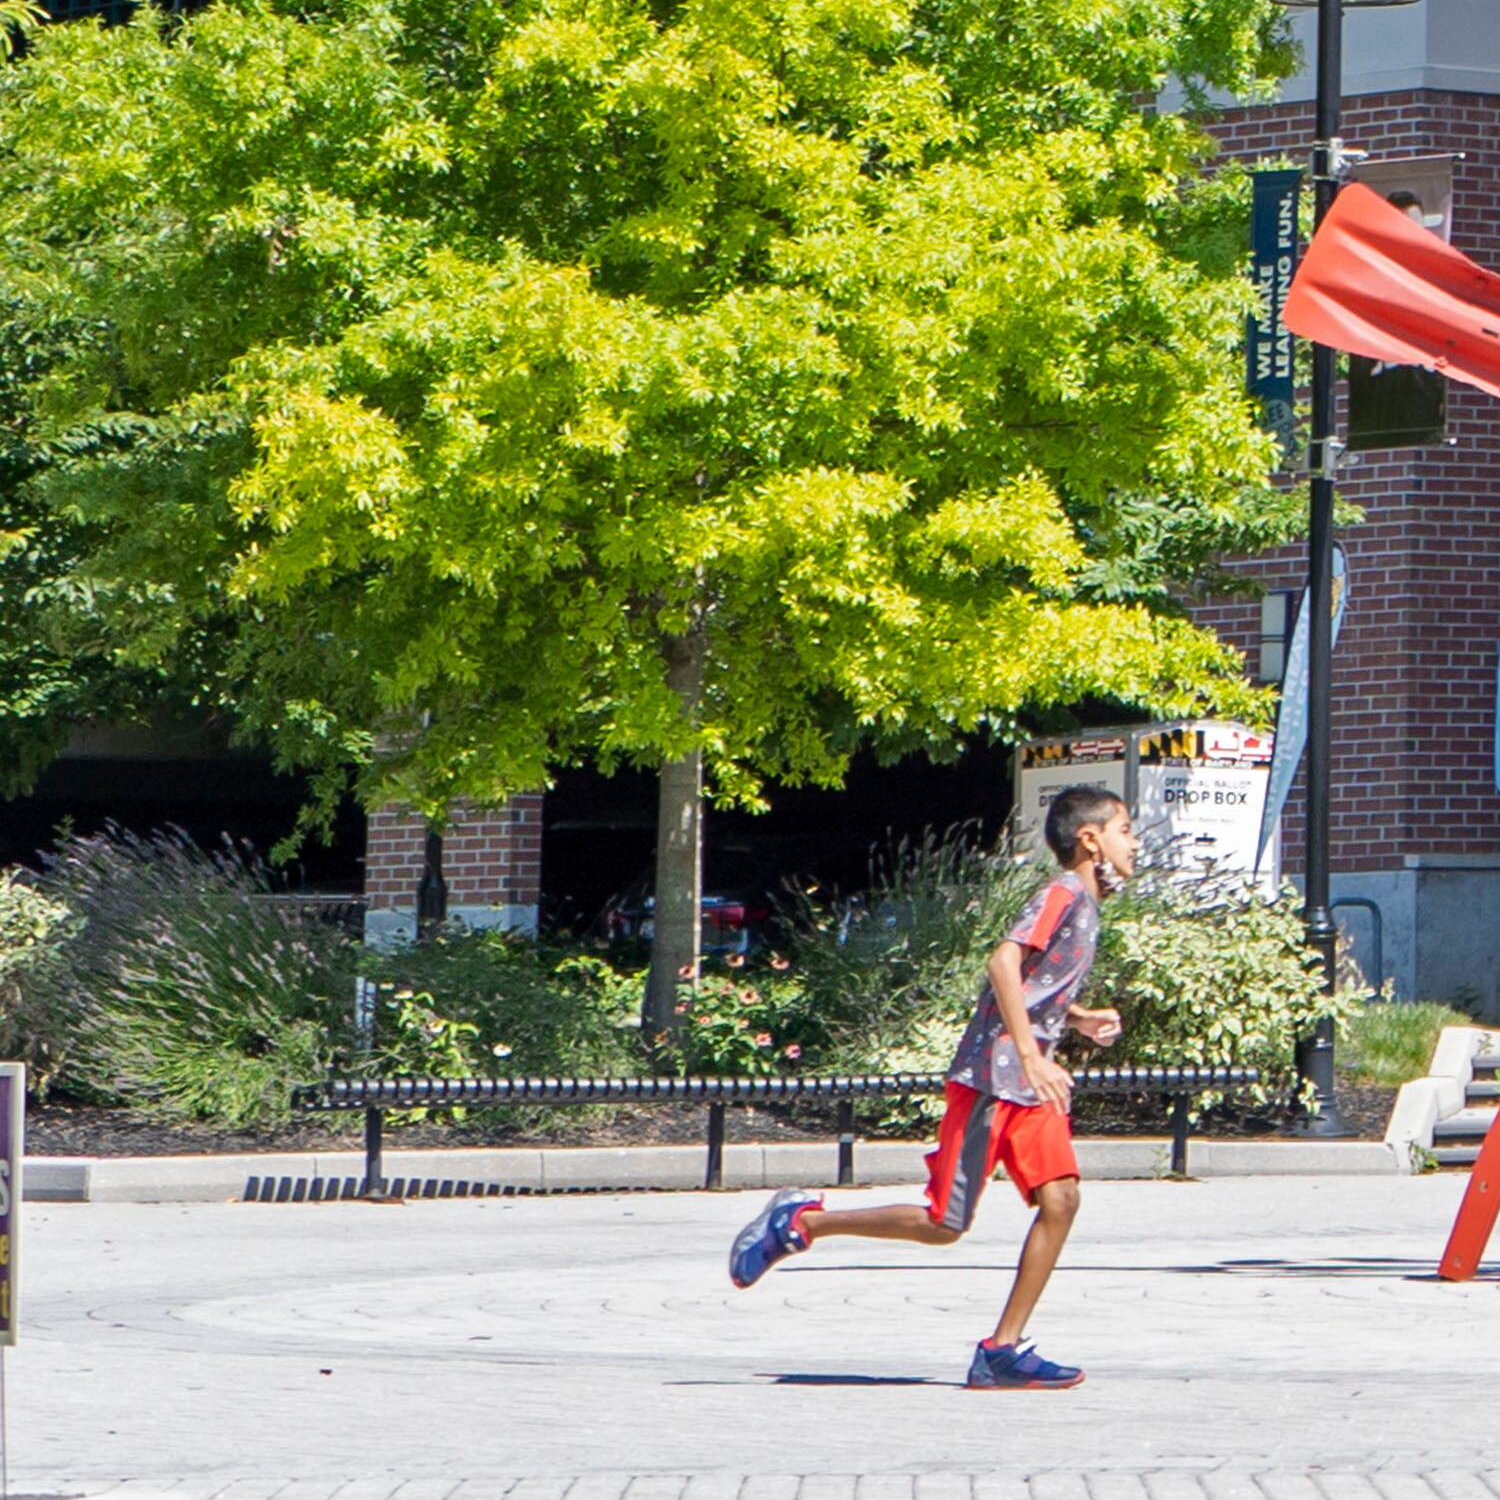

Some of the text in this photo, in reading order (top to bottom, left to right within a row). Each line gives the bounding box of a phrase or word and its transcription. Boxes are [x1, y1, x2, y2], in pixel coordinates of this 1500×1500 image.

[1278, 191, 1293, 248] FUN.
[1257, 264, 1274, 379] WE MAKE
[1164, 789, 1248, 805] DROP BOX
